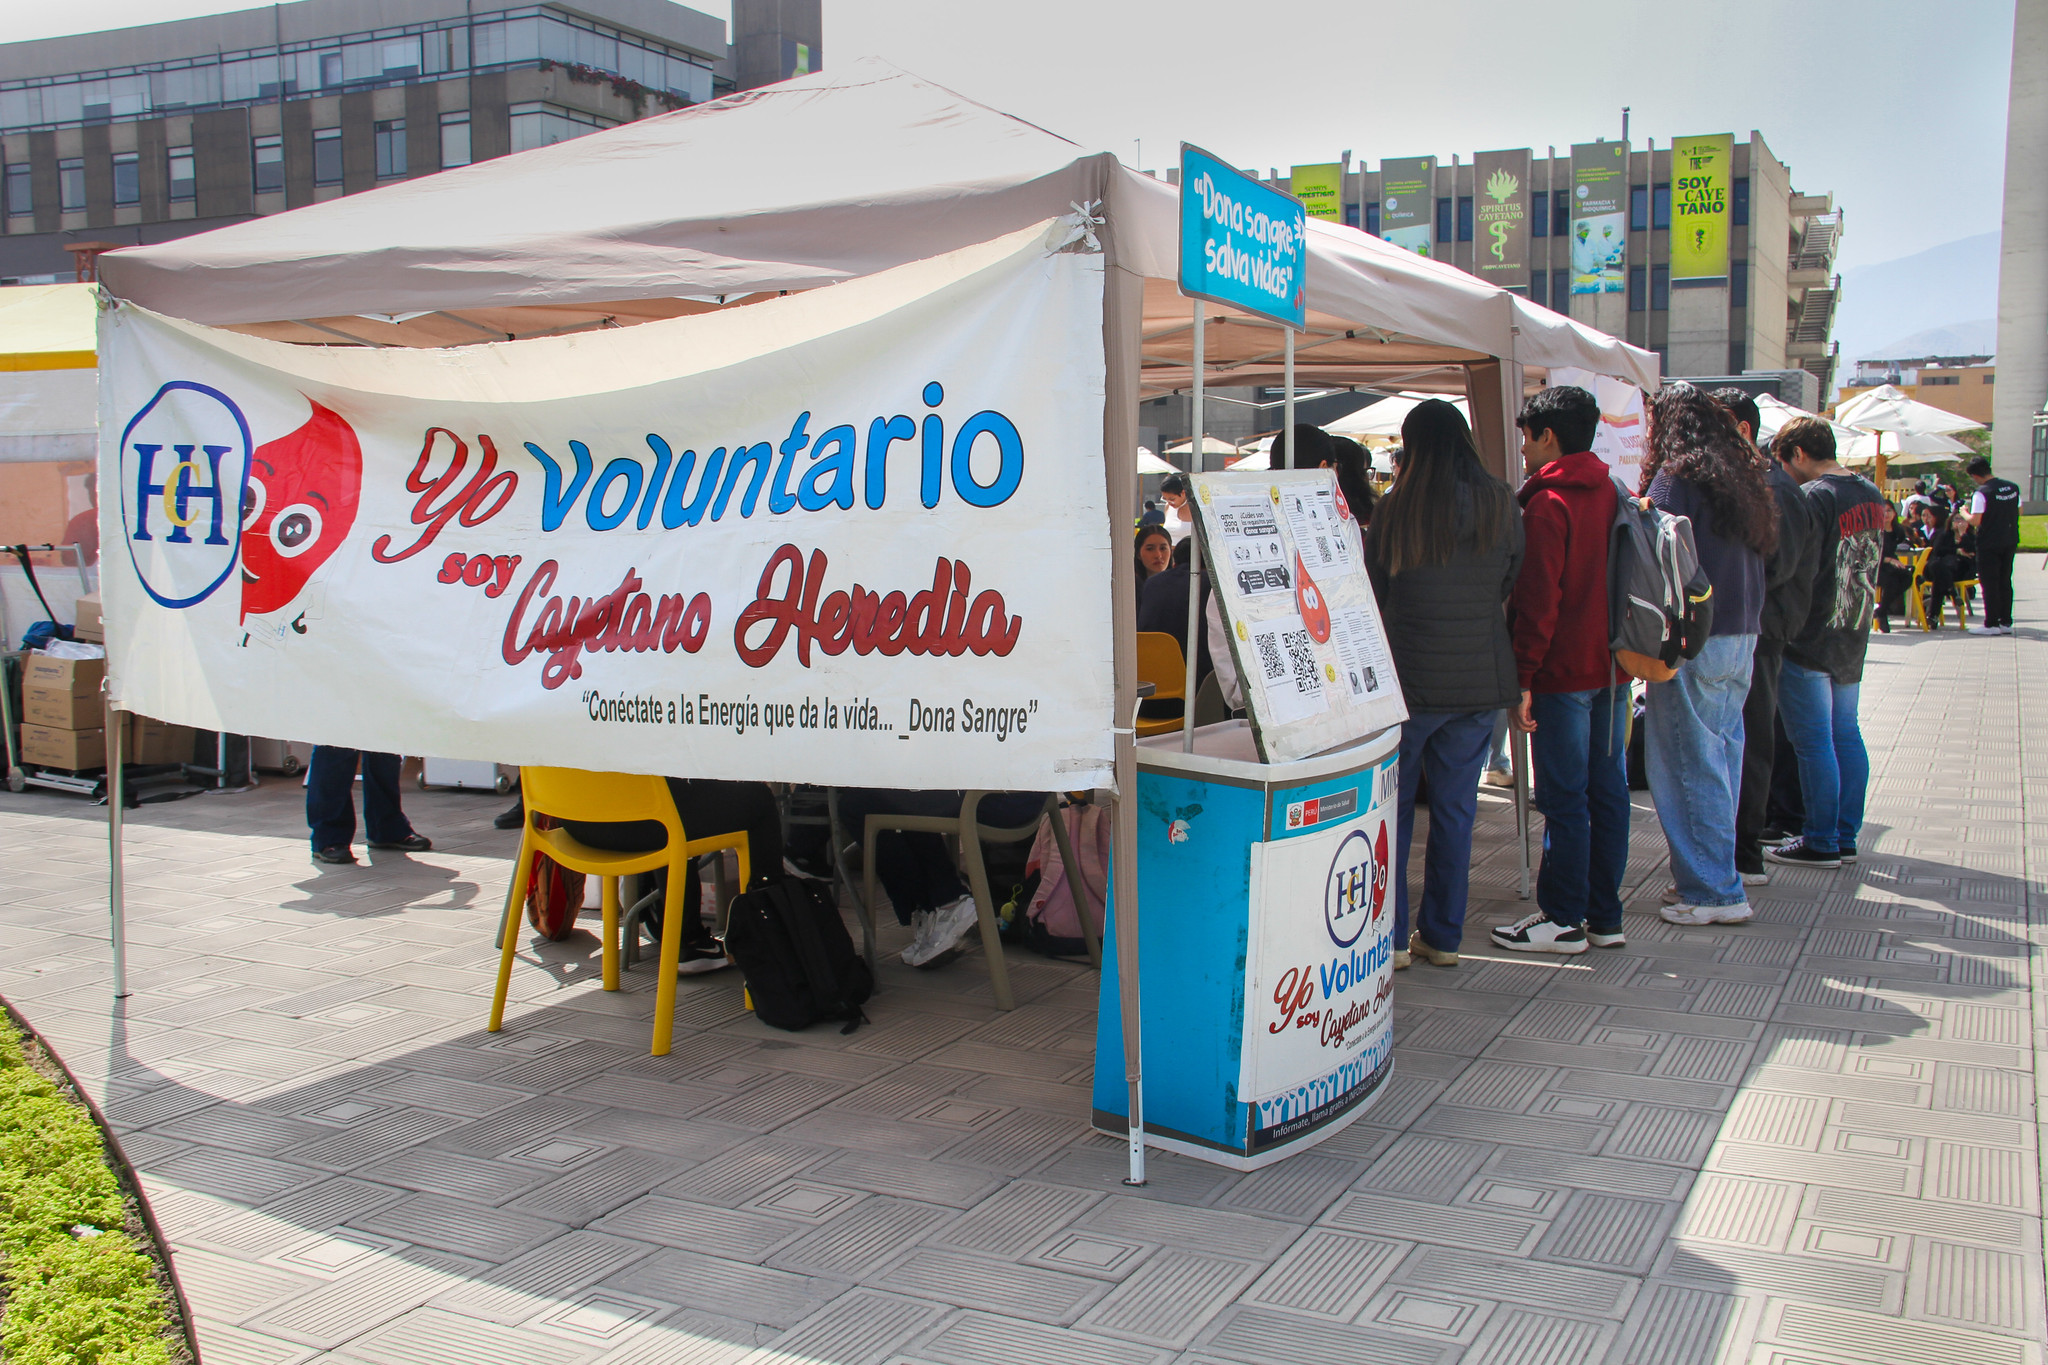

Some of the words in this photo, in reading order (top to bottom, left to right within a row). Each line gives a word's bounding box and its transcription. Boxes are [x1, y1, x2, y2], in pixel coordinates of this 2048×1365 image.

[1678, 176, 1712, 190] SOY
[1298, 190, 1335, 199] PRESTIGIO
[1685, 188, 1725, 202] CAYE
[1480, 203, 1521, 213] SPIRITUS
[1677, 201, 1725, 215] TANO
[1478, 211, 1524, 221] CAYETANO
[372, 427, 518, 563] Yo
[1220, 513, 1234, 521] ama
[1224, 519, 1238, 527] dona
[437, 552, 522, 599] soy
[502, 559, 712, 690] Cayetano
[734, 543, 1022, 668] Heredia
[667, 701, 676, 724] a
[681, 693, 694, 725] la
[699, 694, 759, 735] Energía
[764, 703, 794, 736] que
[800, 696, 818, 729] da
[823, 696, 838, 729] la
[844, 697, 893, 731] vida...
[1269, 965, 1314, 1034] Yo
[1296, 1010, 1320, 1029] soy
[1321, 1000, 1370, 1048] Cayetano
[1273, 1117, 1310, 1138] Infórmate,
[1311, 1107, 1328, 1122] llama
[1329, 1099, 1344, 1116] gratis
